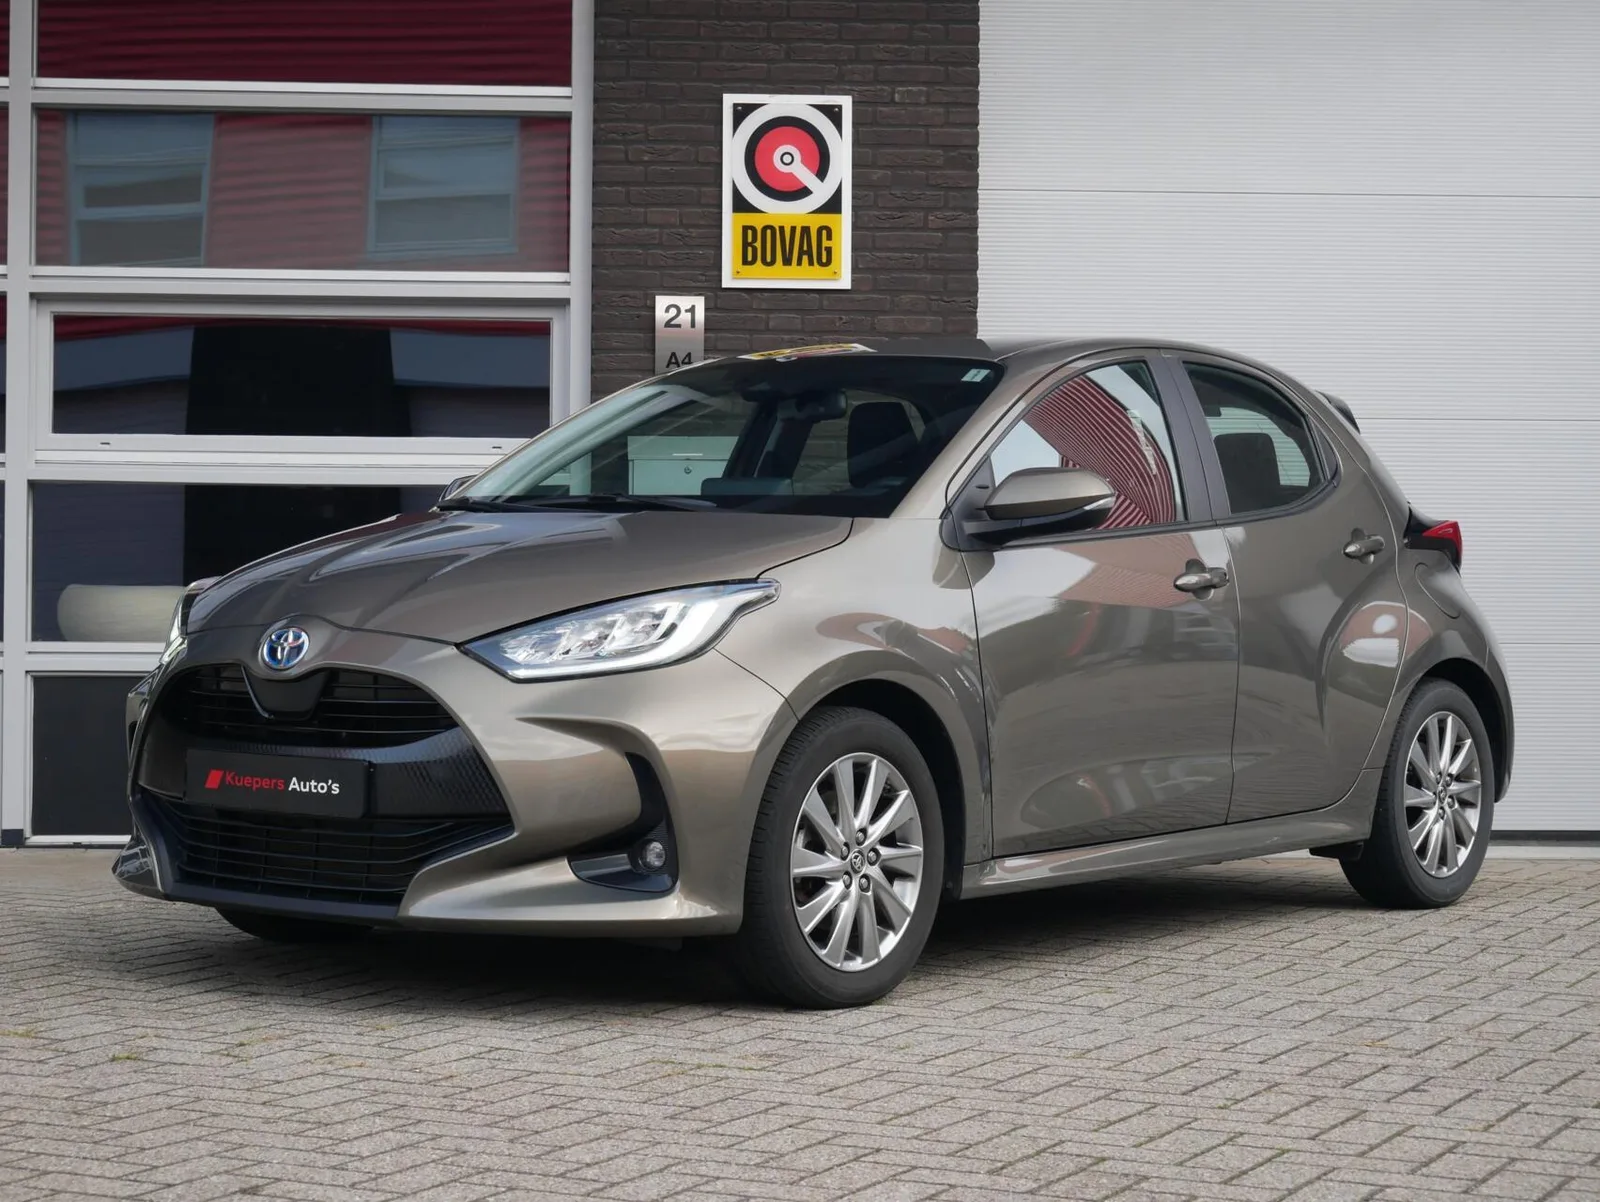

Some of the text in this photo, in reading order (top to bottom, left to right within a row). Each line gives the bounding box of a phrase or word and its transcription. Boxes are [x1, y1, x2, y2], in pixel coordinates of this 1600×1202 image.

[741, 224, 833, 267] BOVAG
[663, 303, 697, 329] 21
[665, 351, 693, 369] A4
[225, 771, 340, 794] Kuepers Auto's
